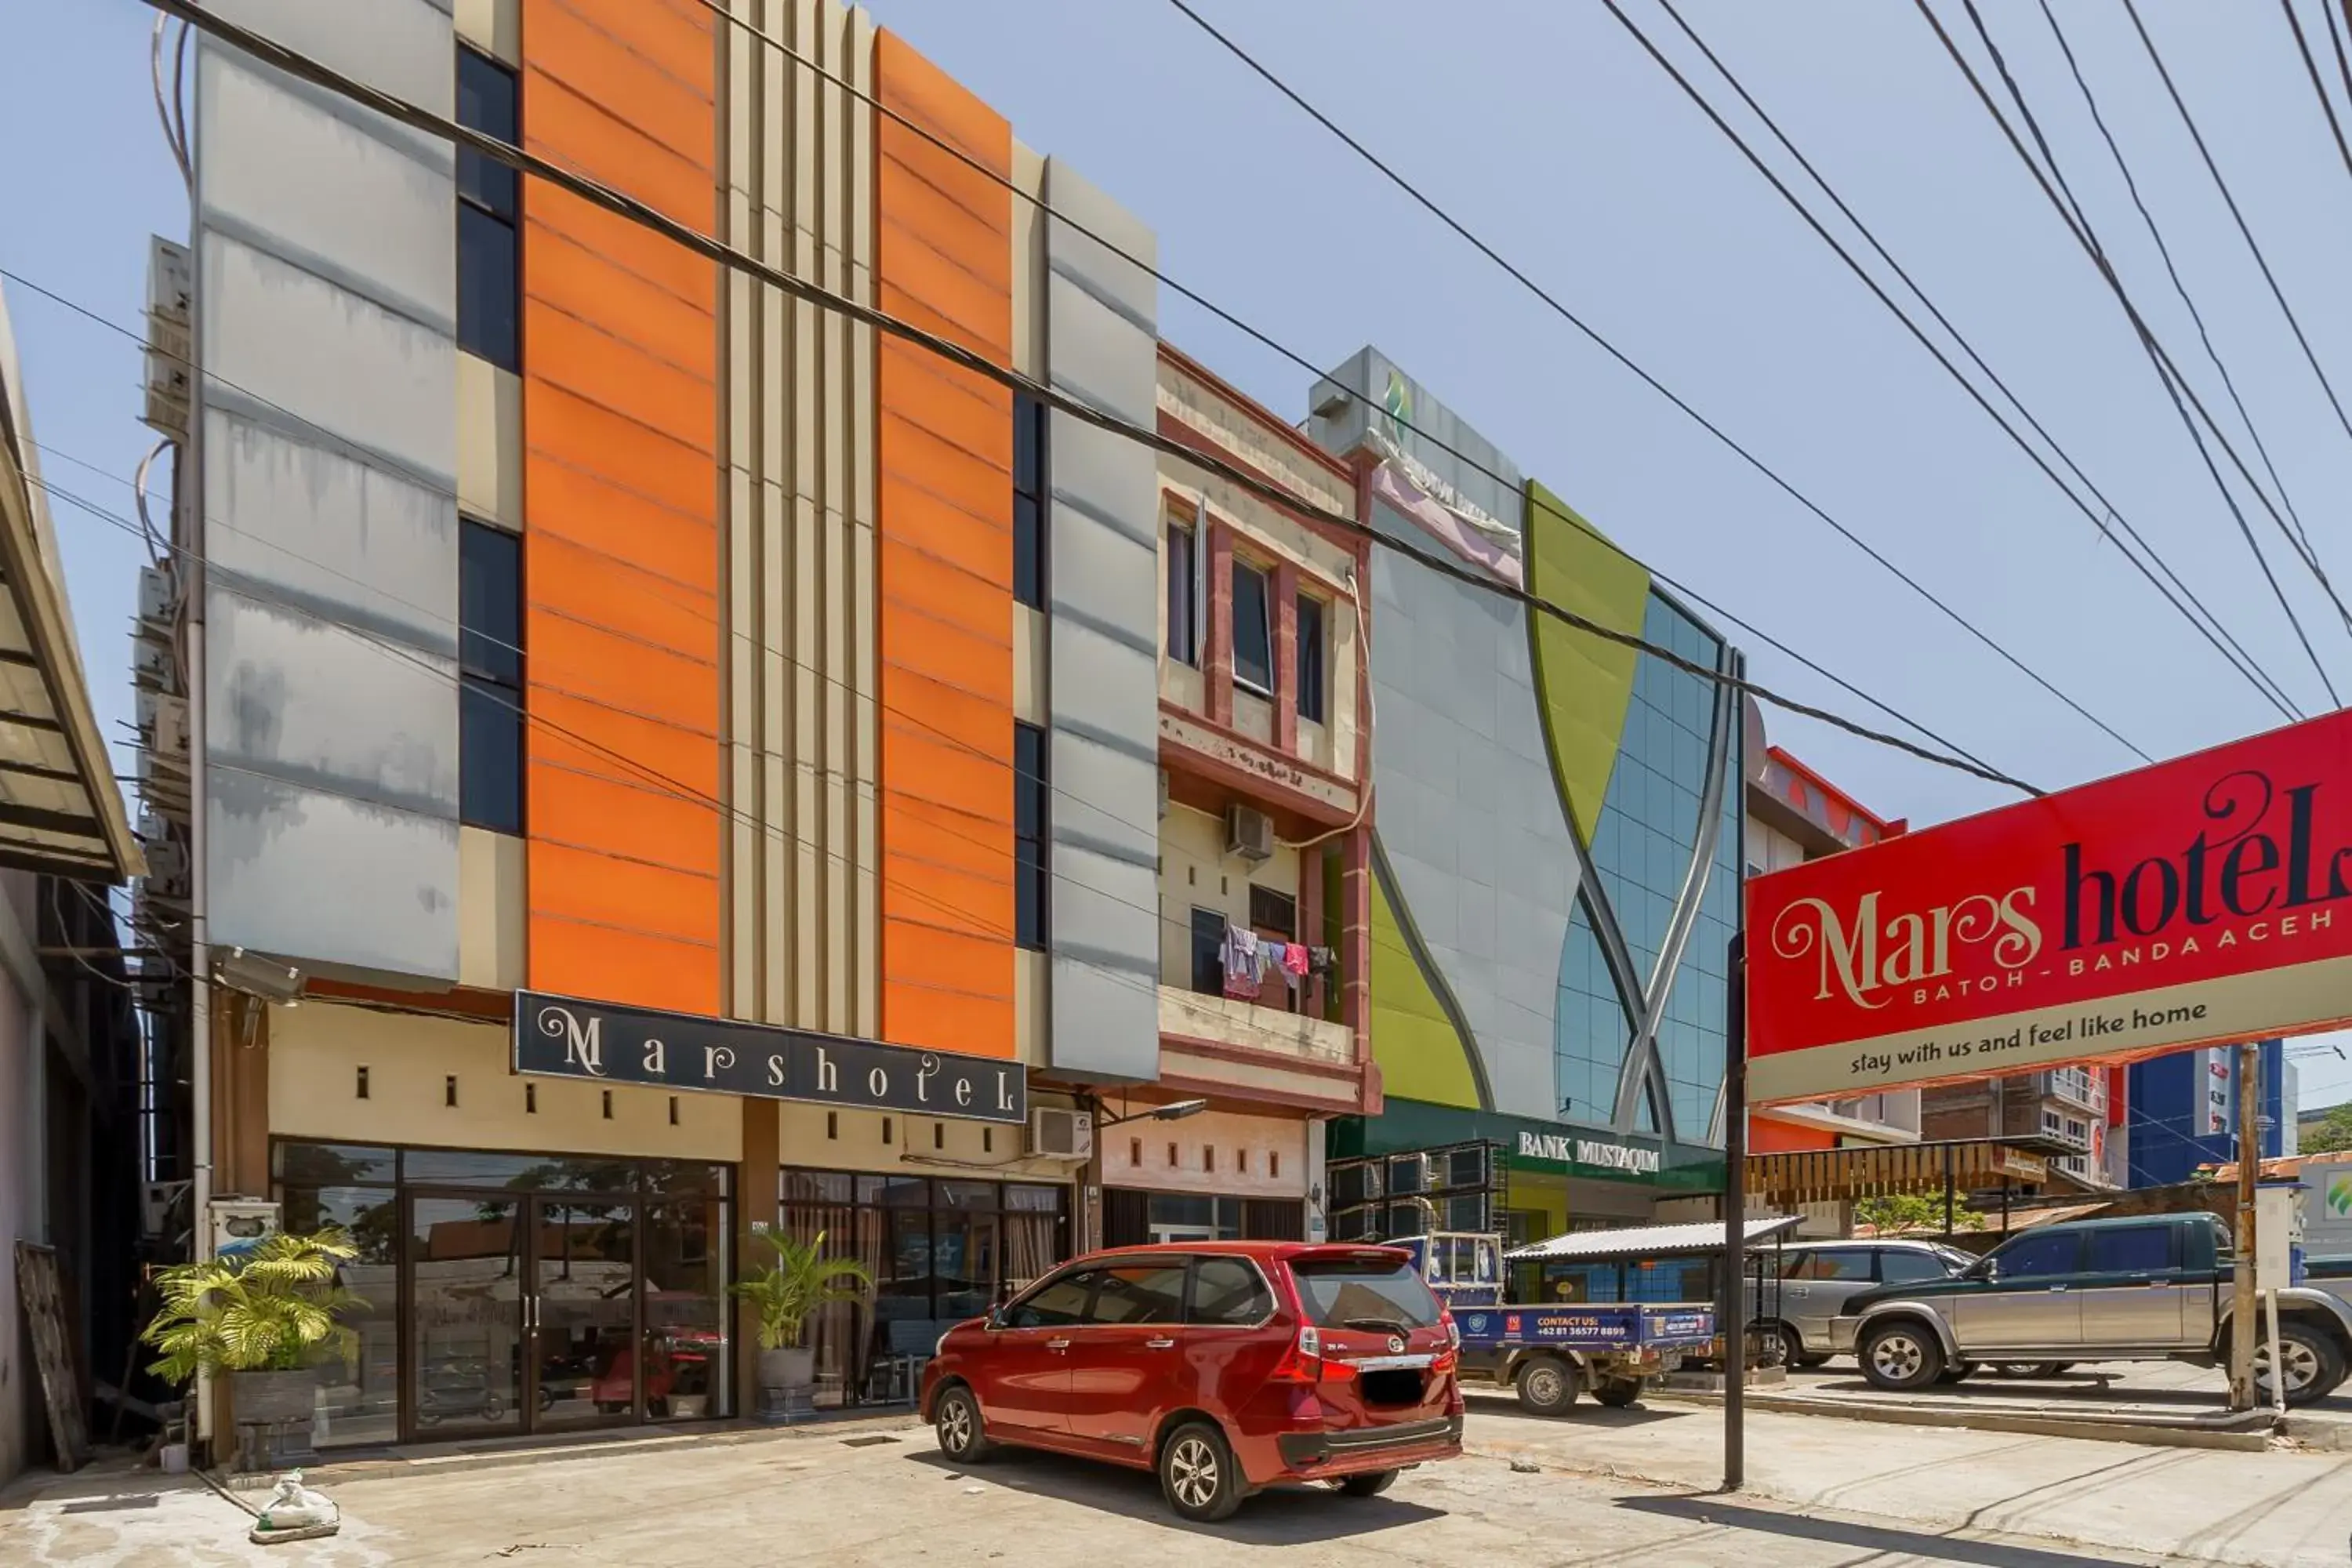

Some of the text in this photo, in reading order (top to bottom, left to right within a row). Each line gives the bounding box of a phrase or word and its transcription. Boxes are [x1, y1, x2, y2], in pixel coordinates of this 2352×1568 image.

[1771, 886, 2042, 1009] Mars
[1913, 971, 2024, 1004] BATOH
[2070, 938, 2200, 977] BANDA
[2216, 909, 2332, 949] ACEH
[1851, 1004, 2206, 1074] stay with us and feel like home
[1519, 1131, 1660, 1175] BANK MUSTAQIM
[1537, 1317, 1599, 1326] CONTACT US:
[1537, 1327, 1555, 1336] +62
[1570, 1327, 1599, 1336] 36577
